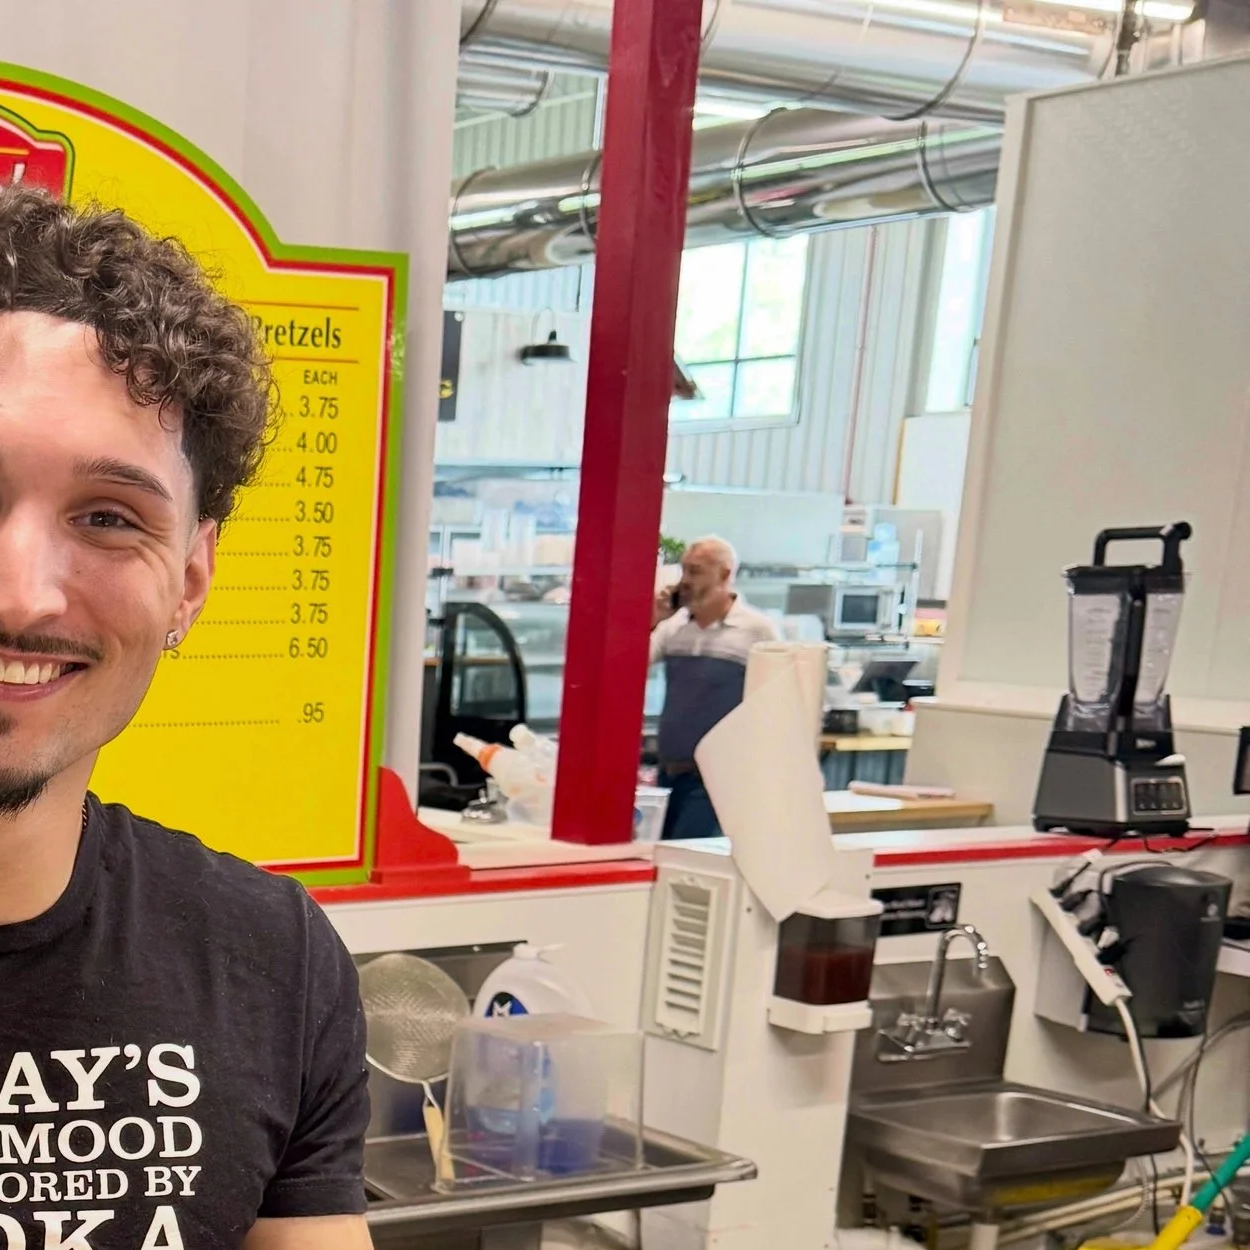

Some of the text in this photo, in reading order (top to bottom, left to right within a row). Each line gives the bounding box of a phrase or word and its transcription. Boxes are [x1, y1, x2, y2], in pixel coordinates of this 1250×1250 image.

[303, 369, 338, 385] EACH
[299, 396, 338, 420] 3.75
[297, 431, 337, 454] 4.00
[296, 466, 334, 488] 4.75
[295, 500, 334, 523] 3.50
[293, 535, 332, 557] 3.75
[292, 569, 330, 592] 3.75
[290, 603, 328, 624] 3.75
[289, 637, 328, 659] 6.50
[144, 1166, 202, 1197] BY
